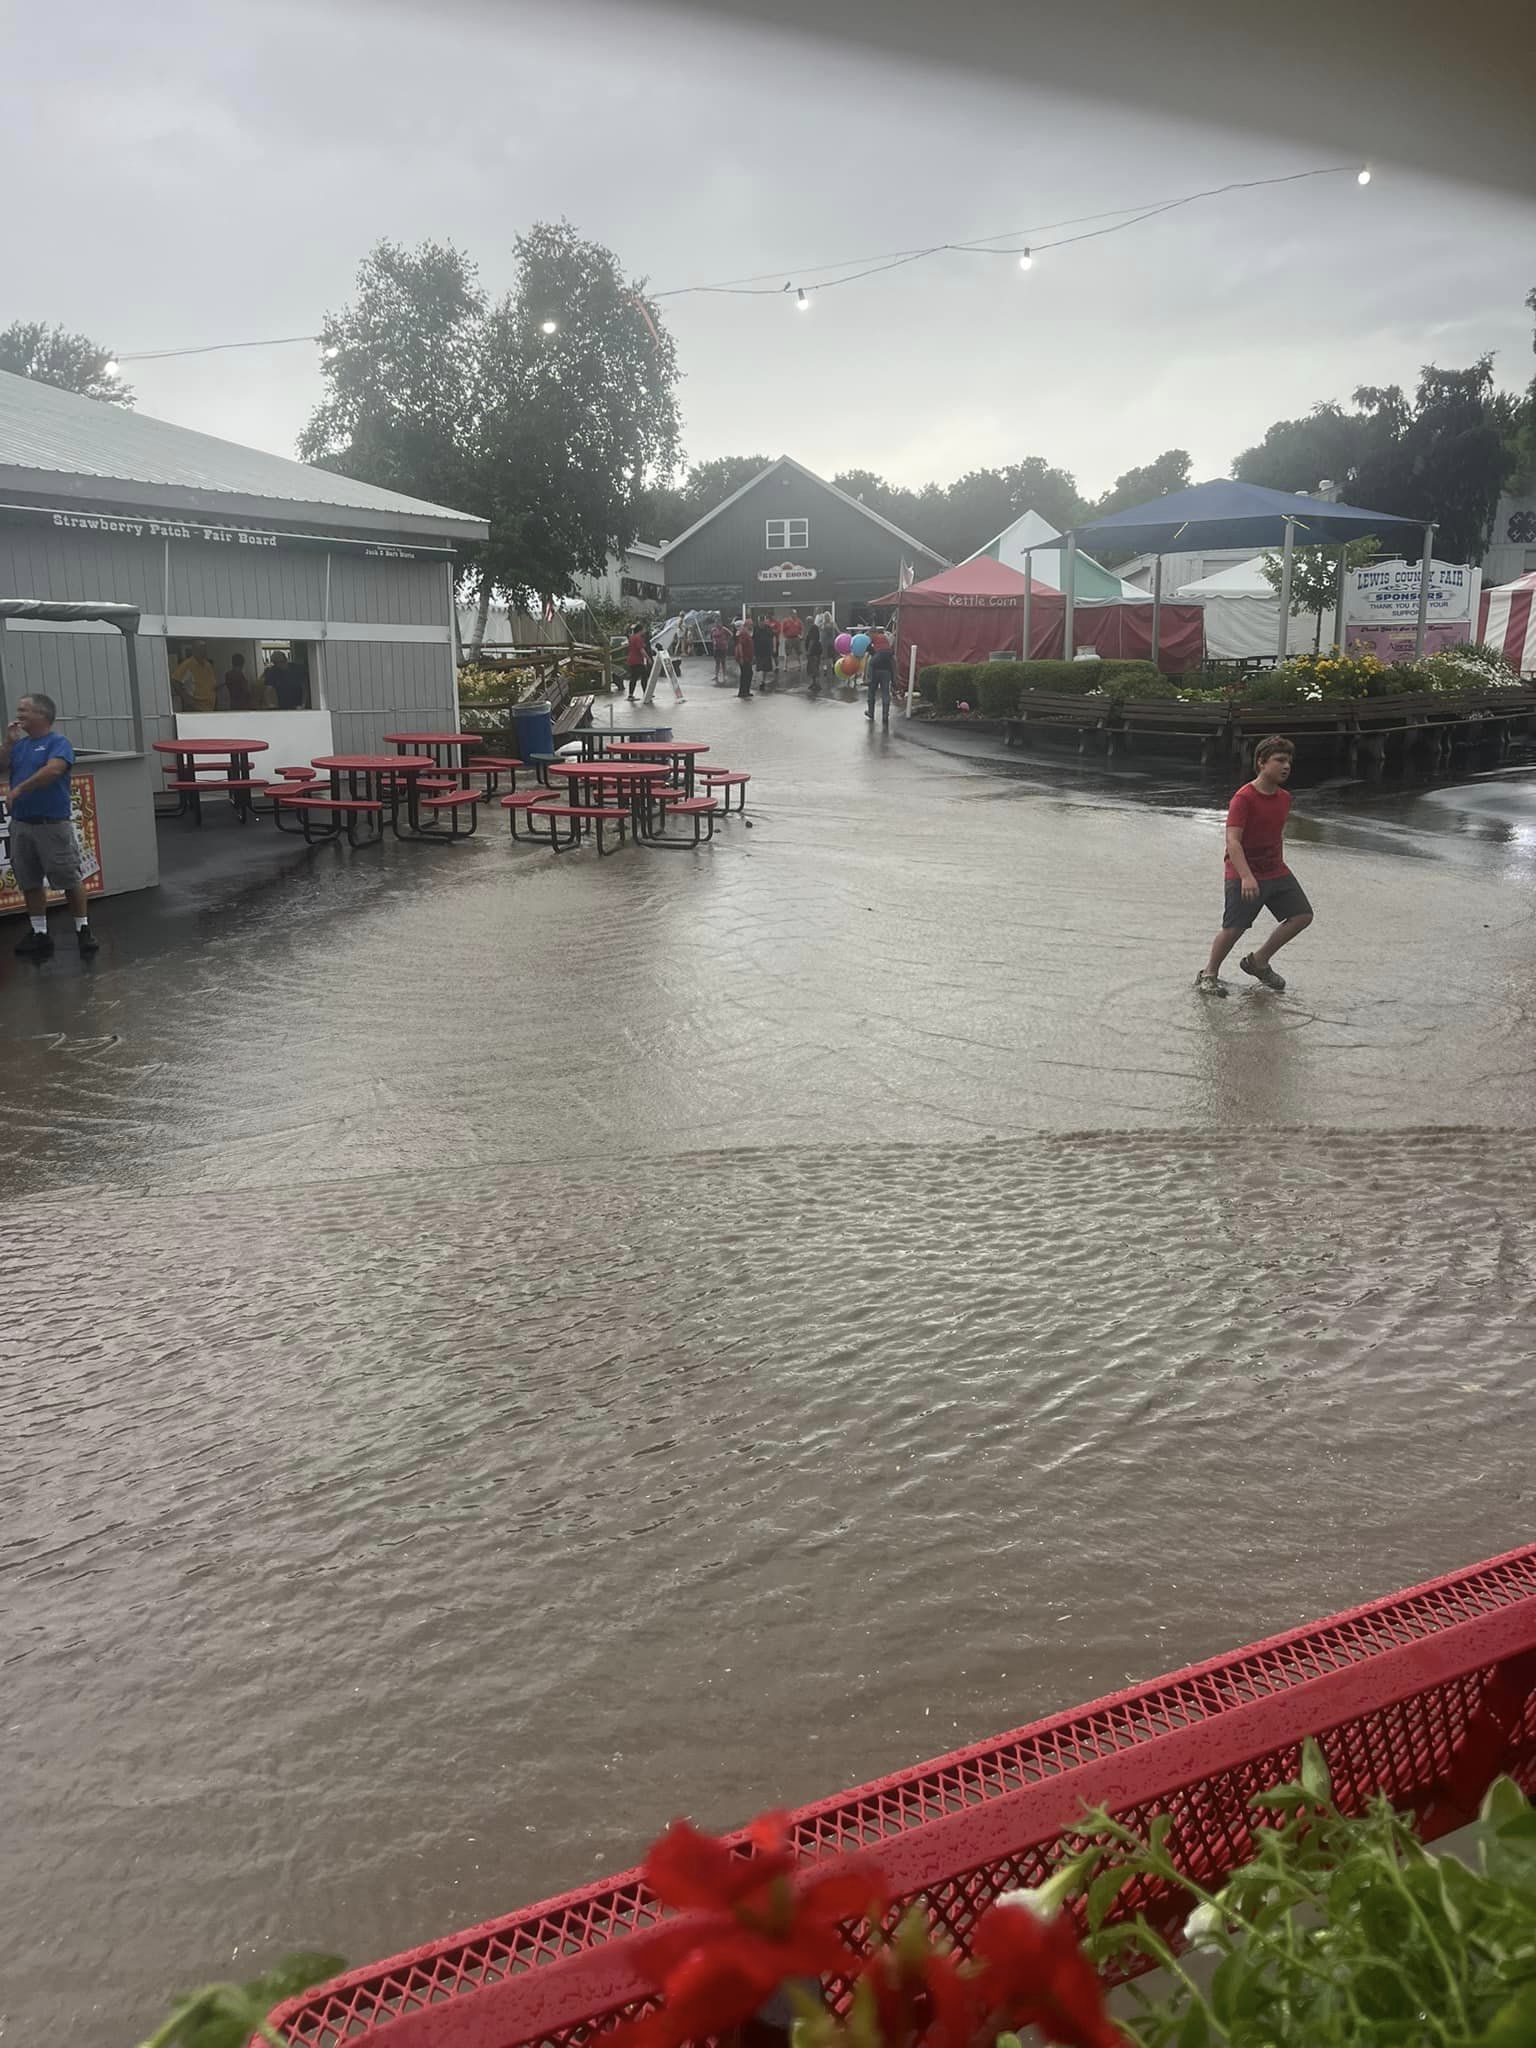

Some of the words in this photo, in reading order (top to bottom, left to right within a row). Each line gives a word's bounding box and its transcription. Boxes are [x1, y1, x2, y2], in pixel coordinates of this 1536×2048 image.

[53, 514, 143, 536] Strawberry
[150, 523, 191, 538] Patch
[203, 529, 232, 542] Fair
[238, 533, 277, 546] Board
[1357, 572, 1390, 591] LEWIS
[1395, 571, 1435, 582] COUNY
[1440, 570, 1464, 587] FAIR
[948, 594, 985, 606] Kettle
[989, 595, 1017, 606] Corn
